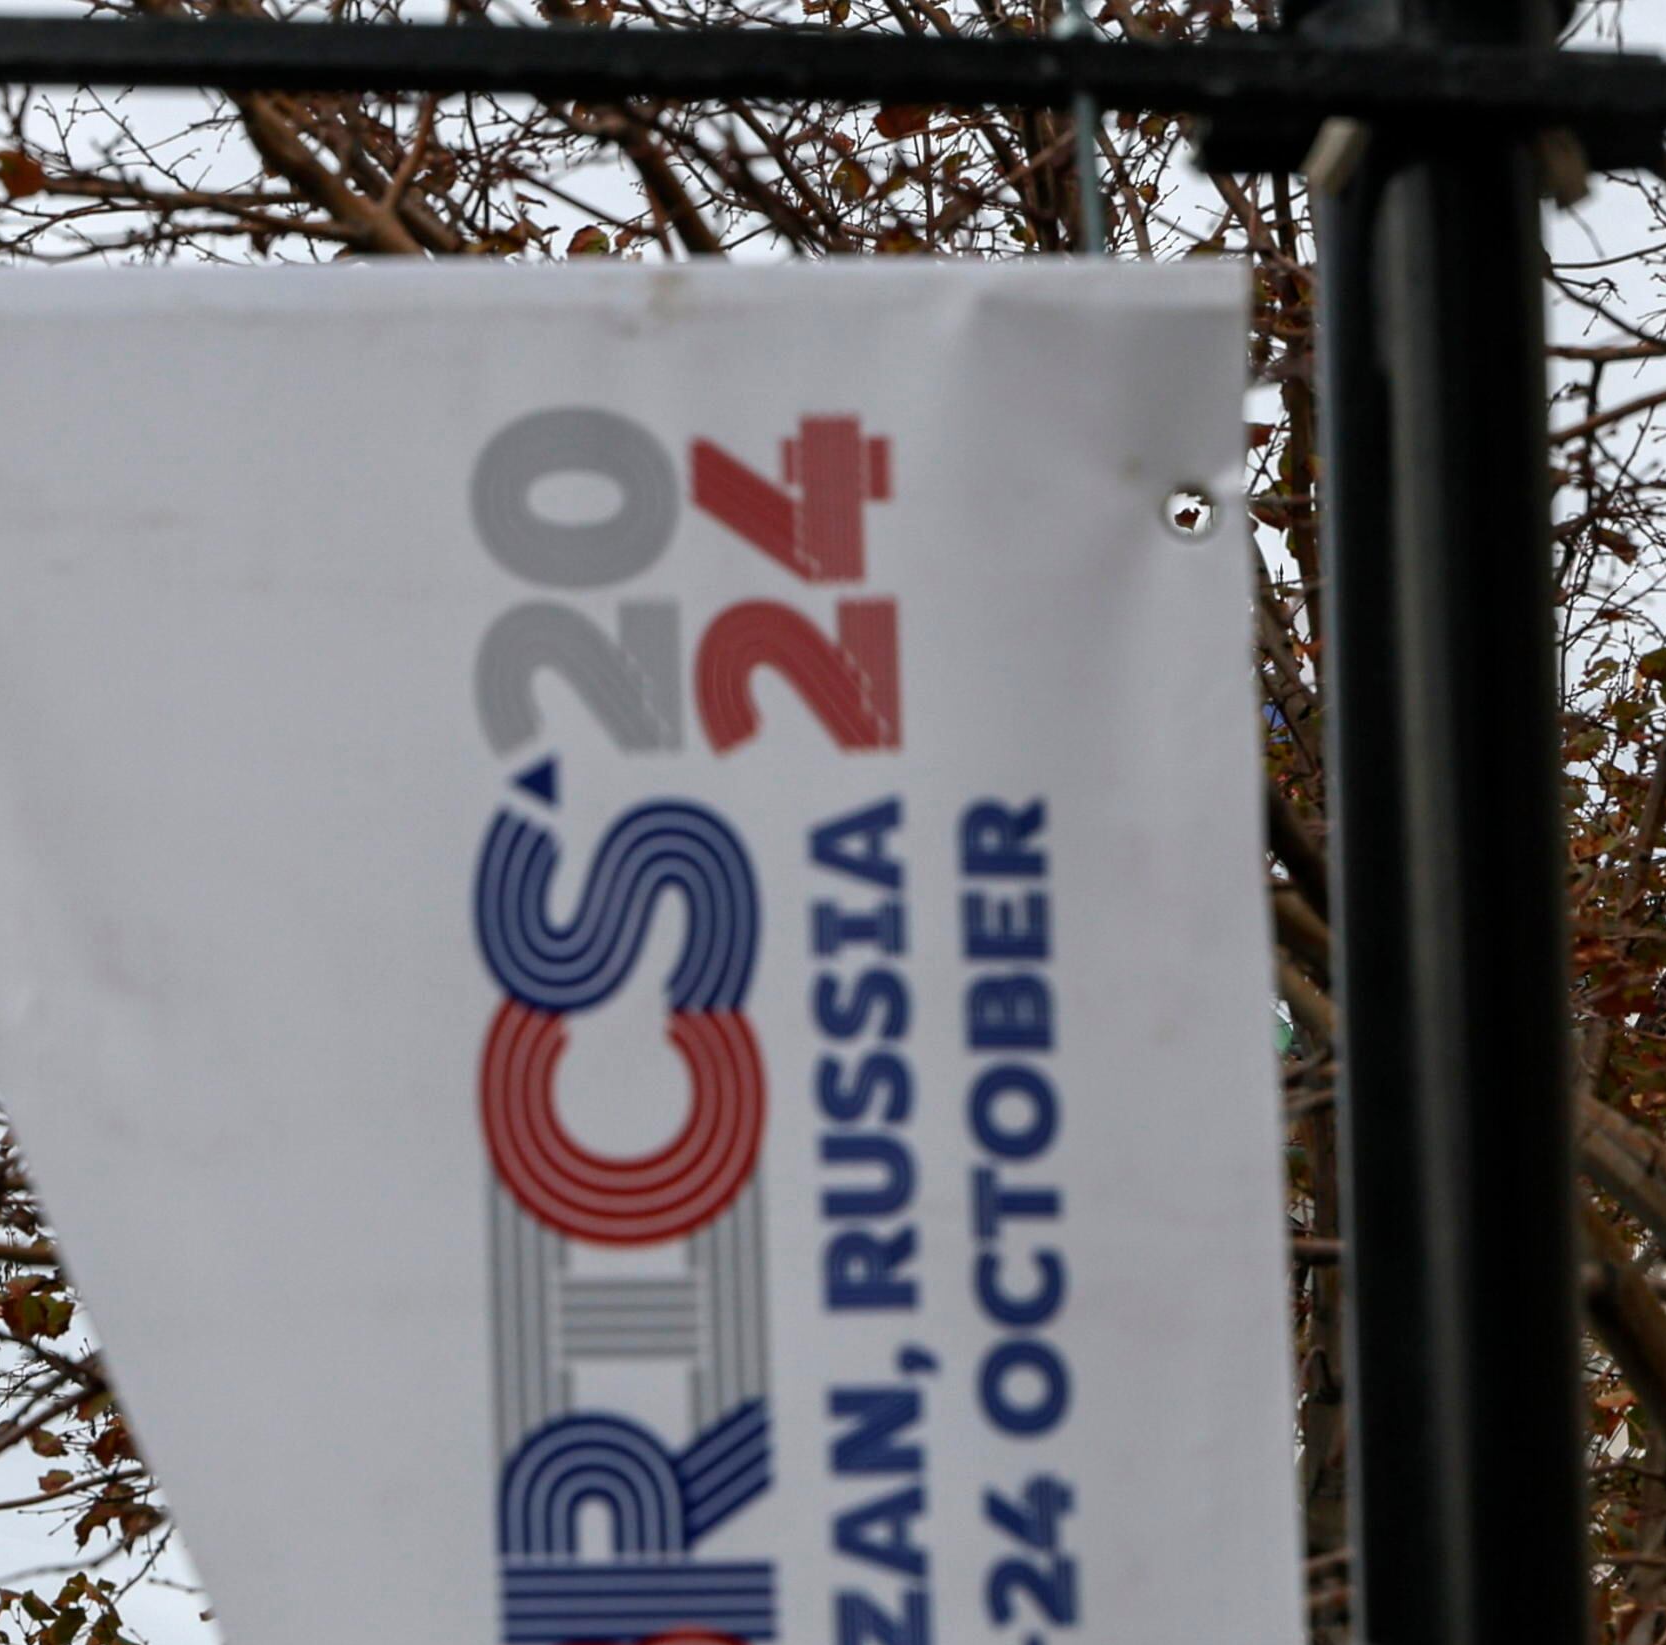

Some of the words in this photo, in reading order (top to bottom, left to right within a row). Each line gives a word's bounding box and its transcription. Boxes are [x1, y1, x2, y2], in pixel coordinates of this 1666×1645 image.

[469, 405, 685, 762] 20
[688, 413, 903, 757] 24
[808, 794, 920, 1312] RUSSIA
[958, 796, 1072, 1438] OCTOBER
